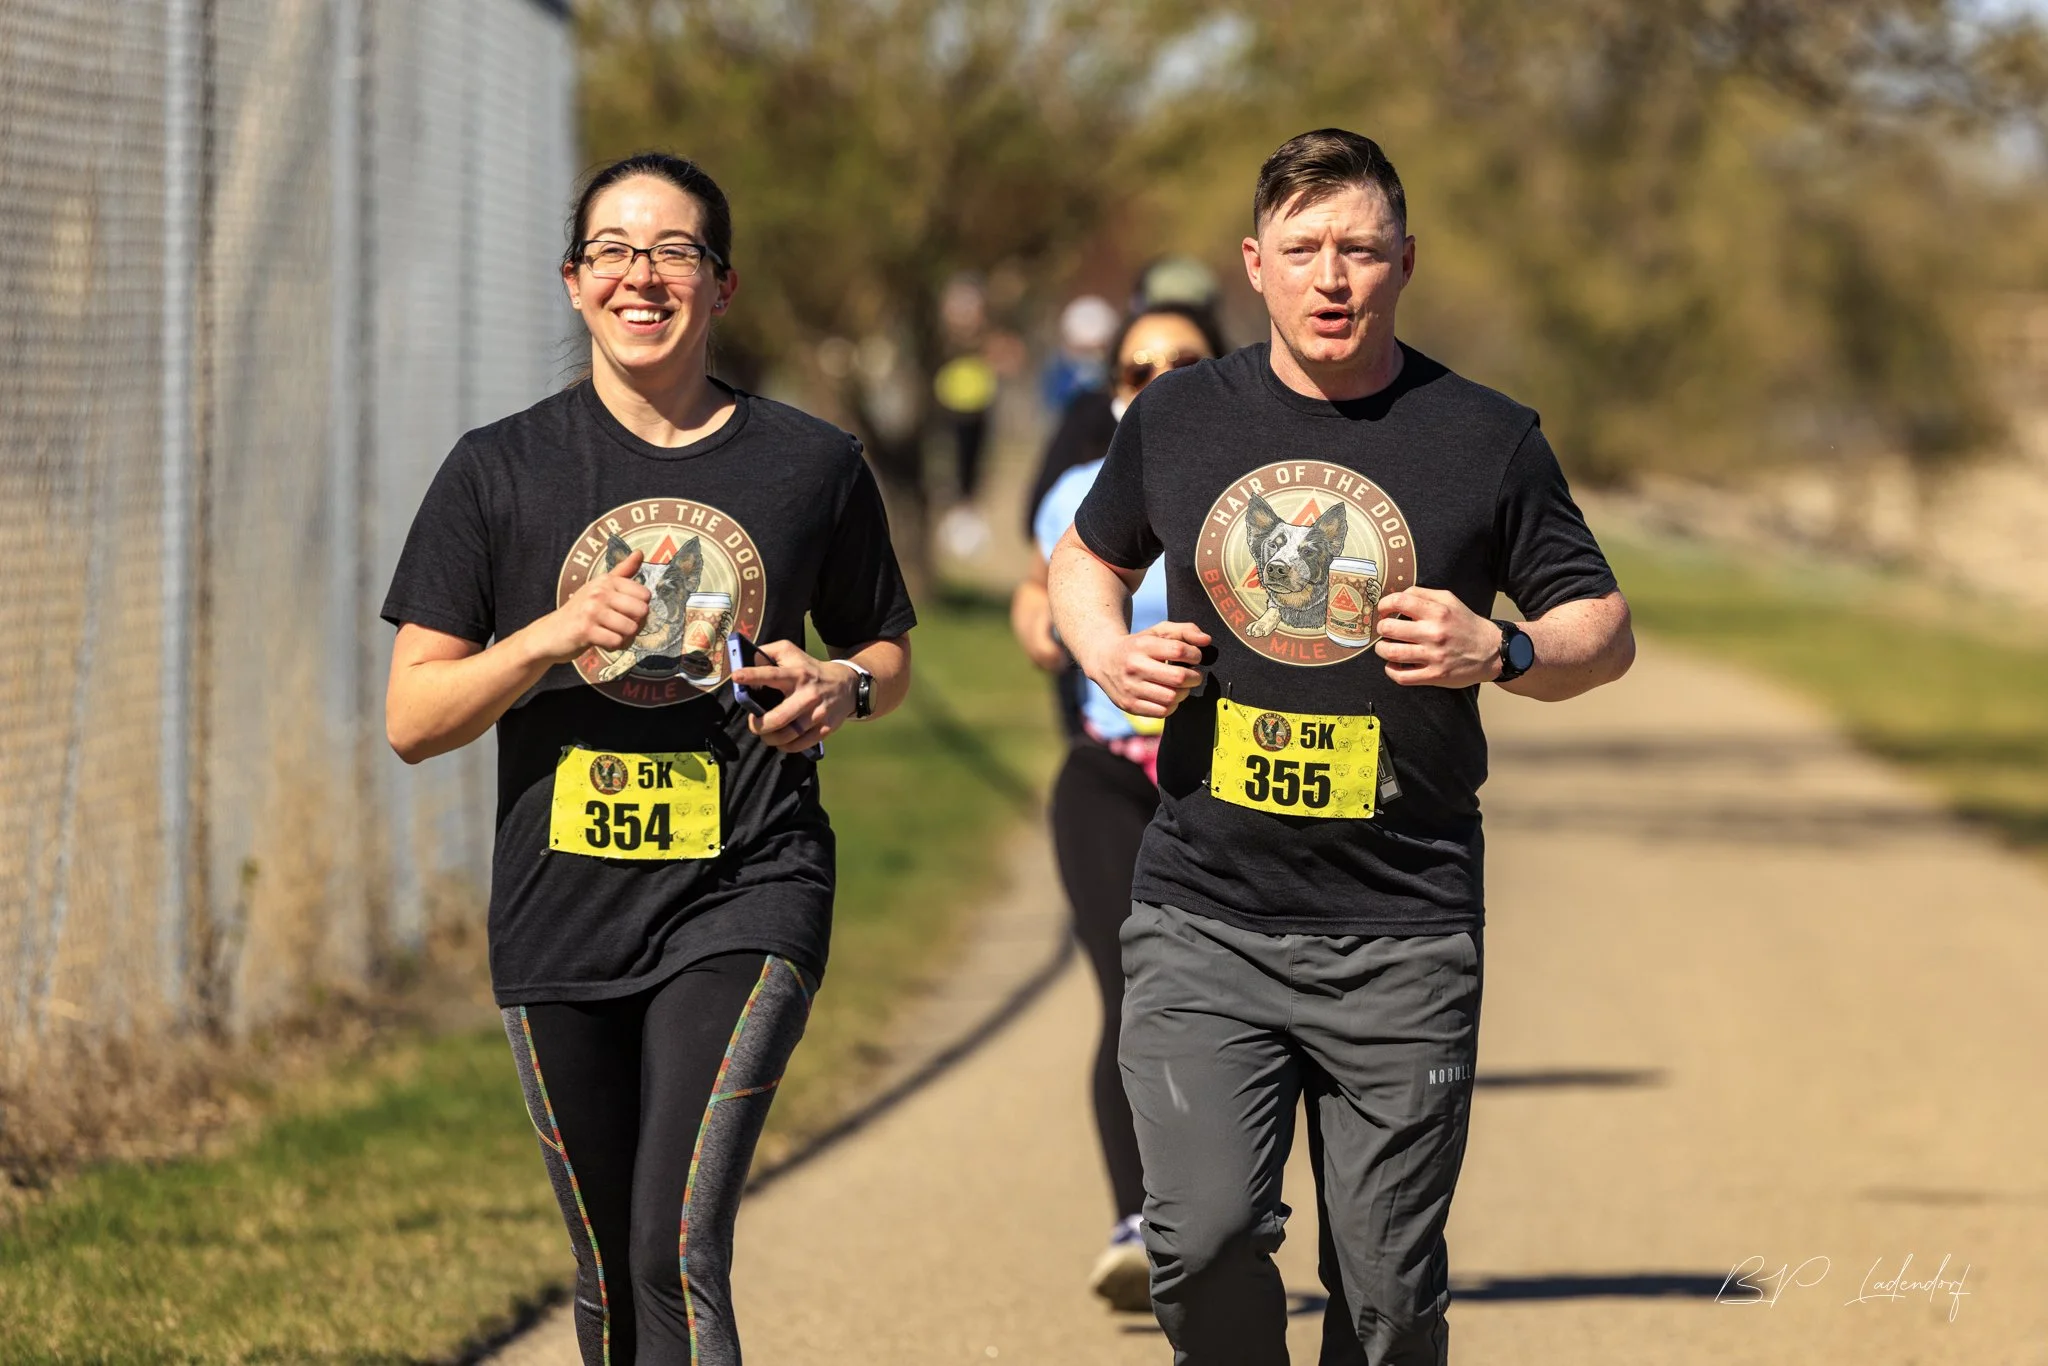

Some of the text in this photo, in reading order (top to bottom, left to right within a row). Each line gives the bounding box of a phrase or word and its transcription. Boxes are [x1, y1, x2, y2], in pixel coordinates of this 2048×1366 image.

[1213, 466, 1407, 549] HAIR OF THE DOG
[573, 504, 760, 581] HAIR OF THE DOG
[1203, 568, 1327, 659] BEER MILE
[622, 682, 677, 699] MILE
[1300, 722, 1335, 750] 5K
[638, 762, 673, 789] 5K
[1245, 754, 1331, 809] 355
[585, 800, 674, 851] 354
[1429, 1064, 1471, 1085] NOBULL
